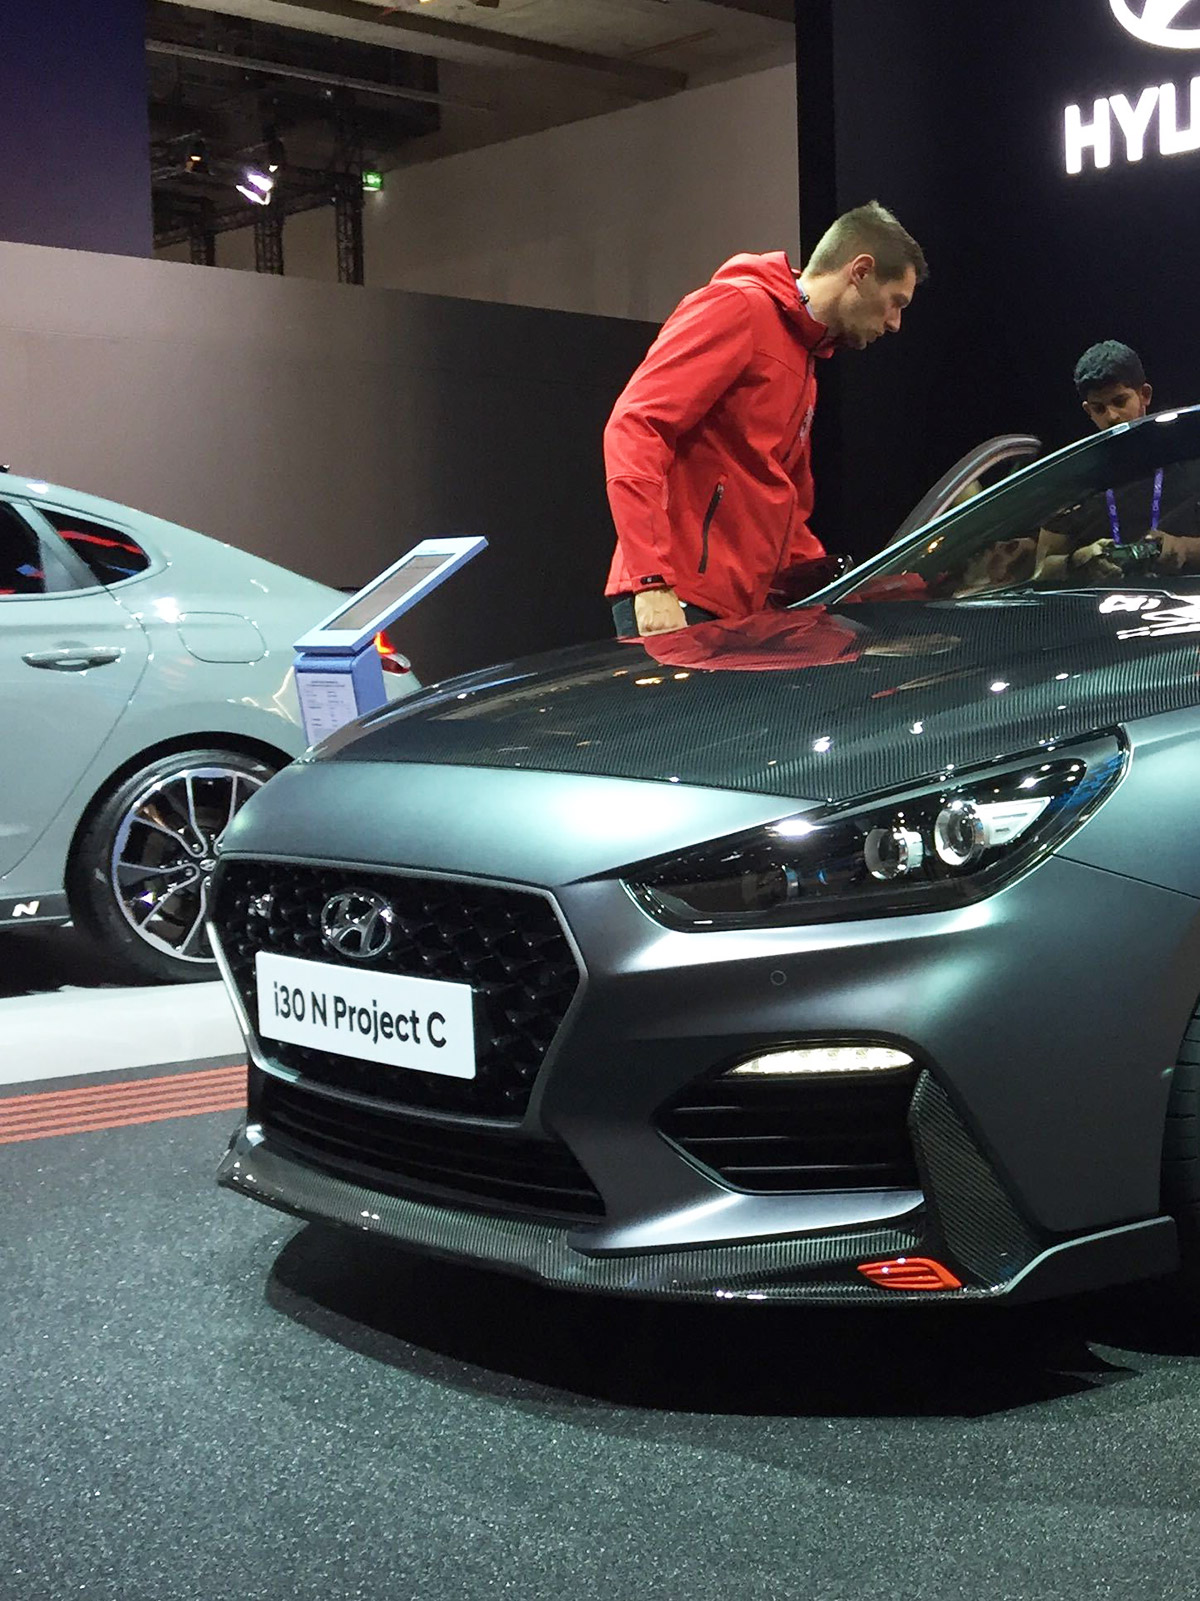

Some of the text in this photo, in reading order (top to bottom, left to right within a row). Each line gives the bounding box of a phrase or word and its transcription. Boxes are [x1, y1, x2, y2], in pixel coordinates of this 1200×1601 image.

[273, 981, 447, 1048] i30 N Project C
